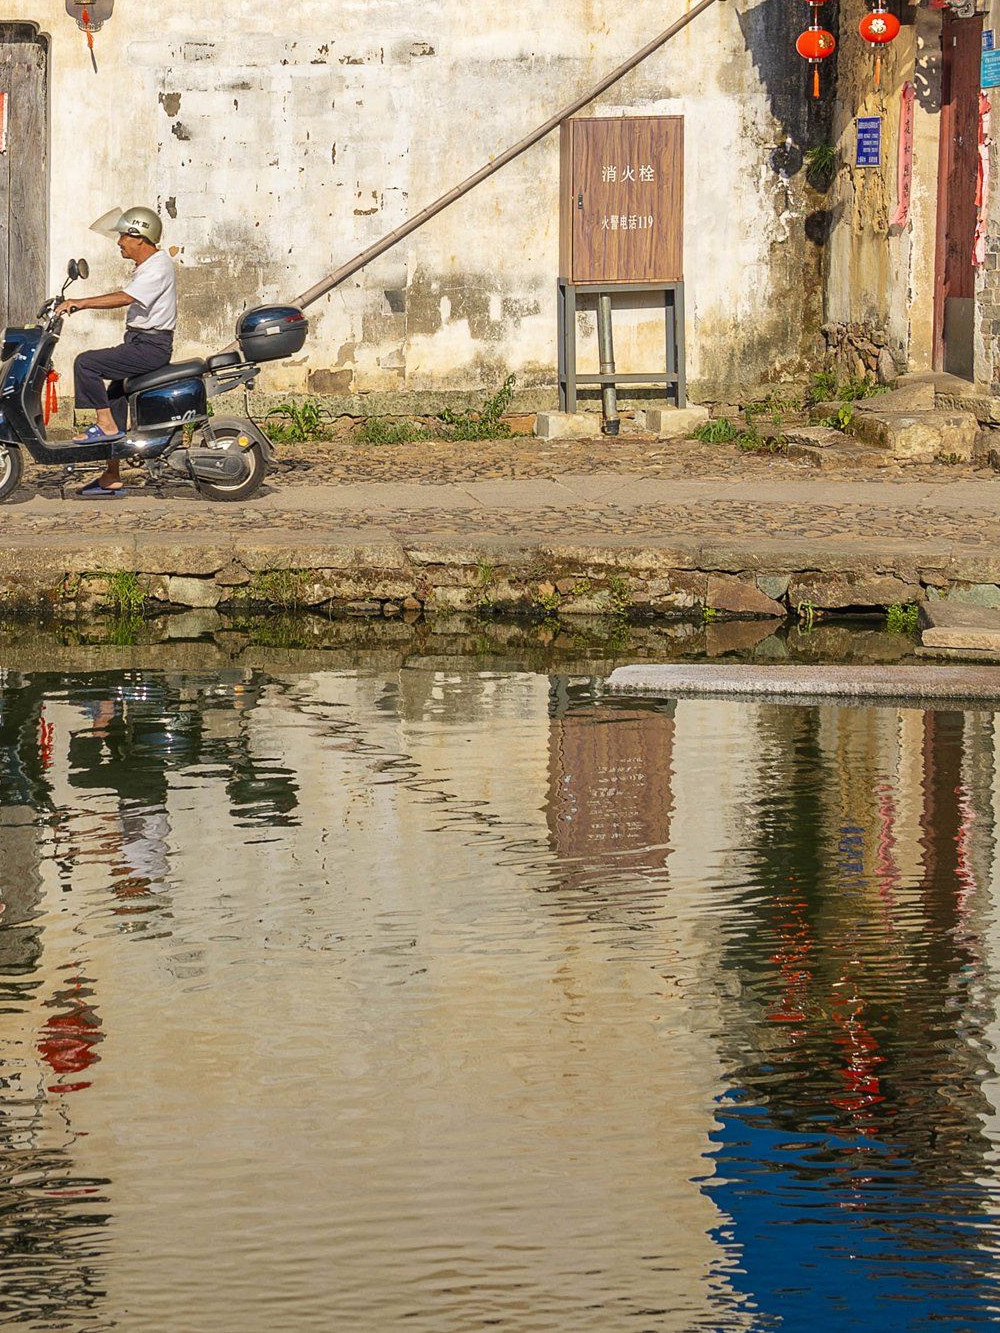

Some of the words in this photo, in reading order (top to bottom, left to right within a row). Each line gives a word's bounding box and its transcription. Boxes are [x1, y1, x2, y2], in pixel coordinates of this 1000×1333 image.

[602, 165, 654, 182] 消火栓
[601, 215, 653, 230] 火警电话119
